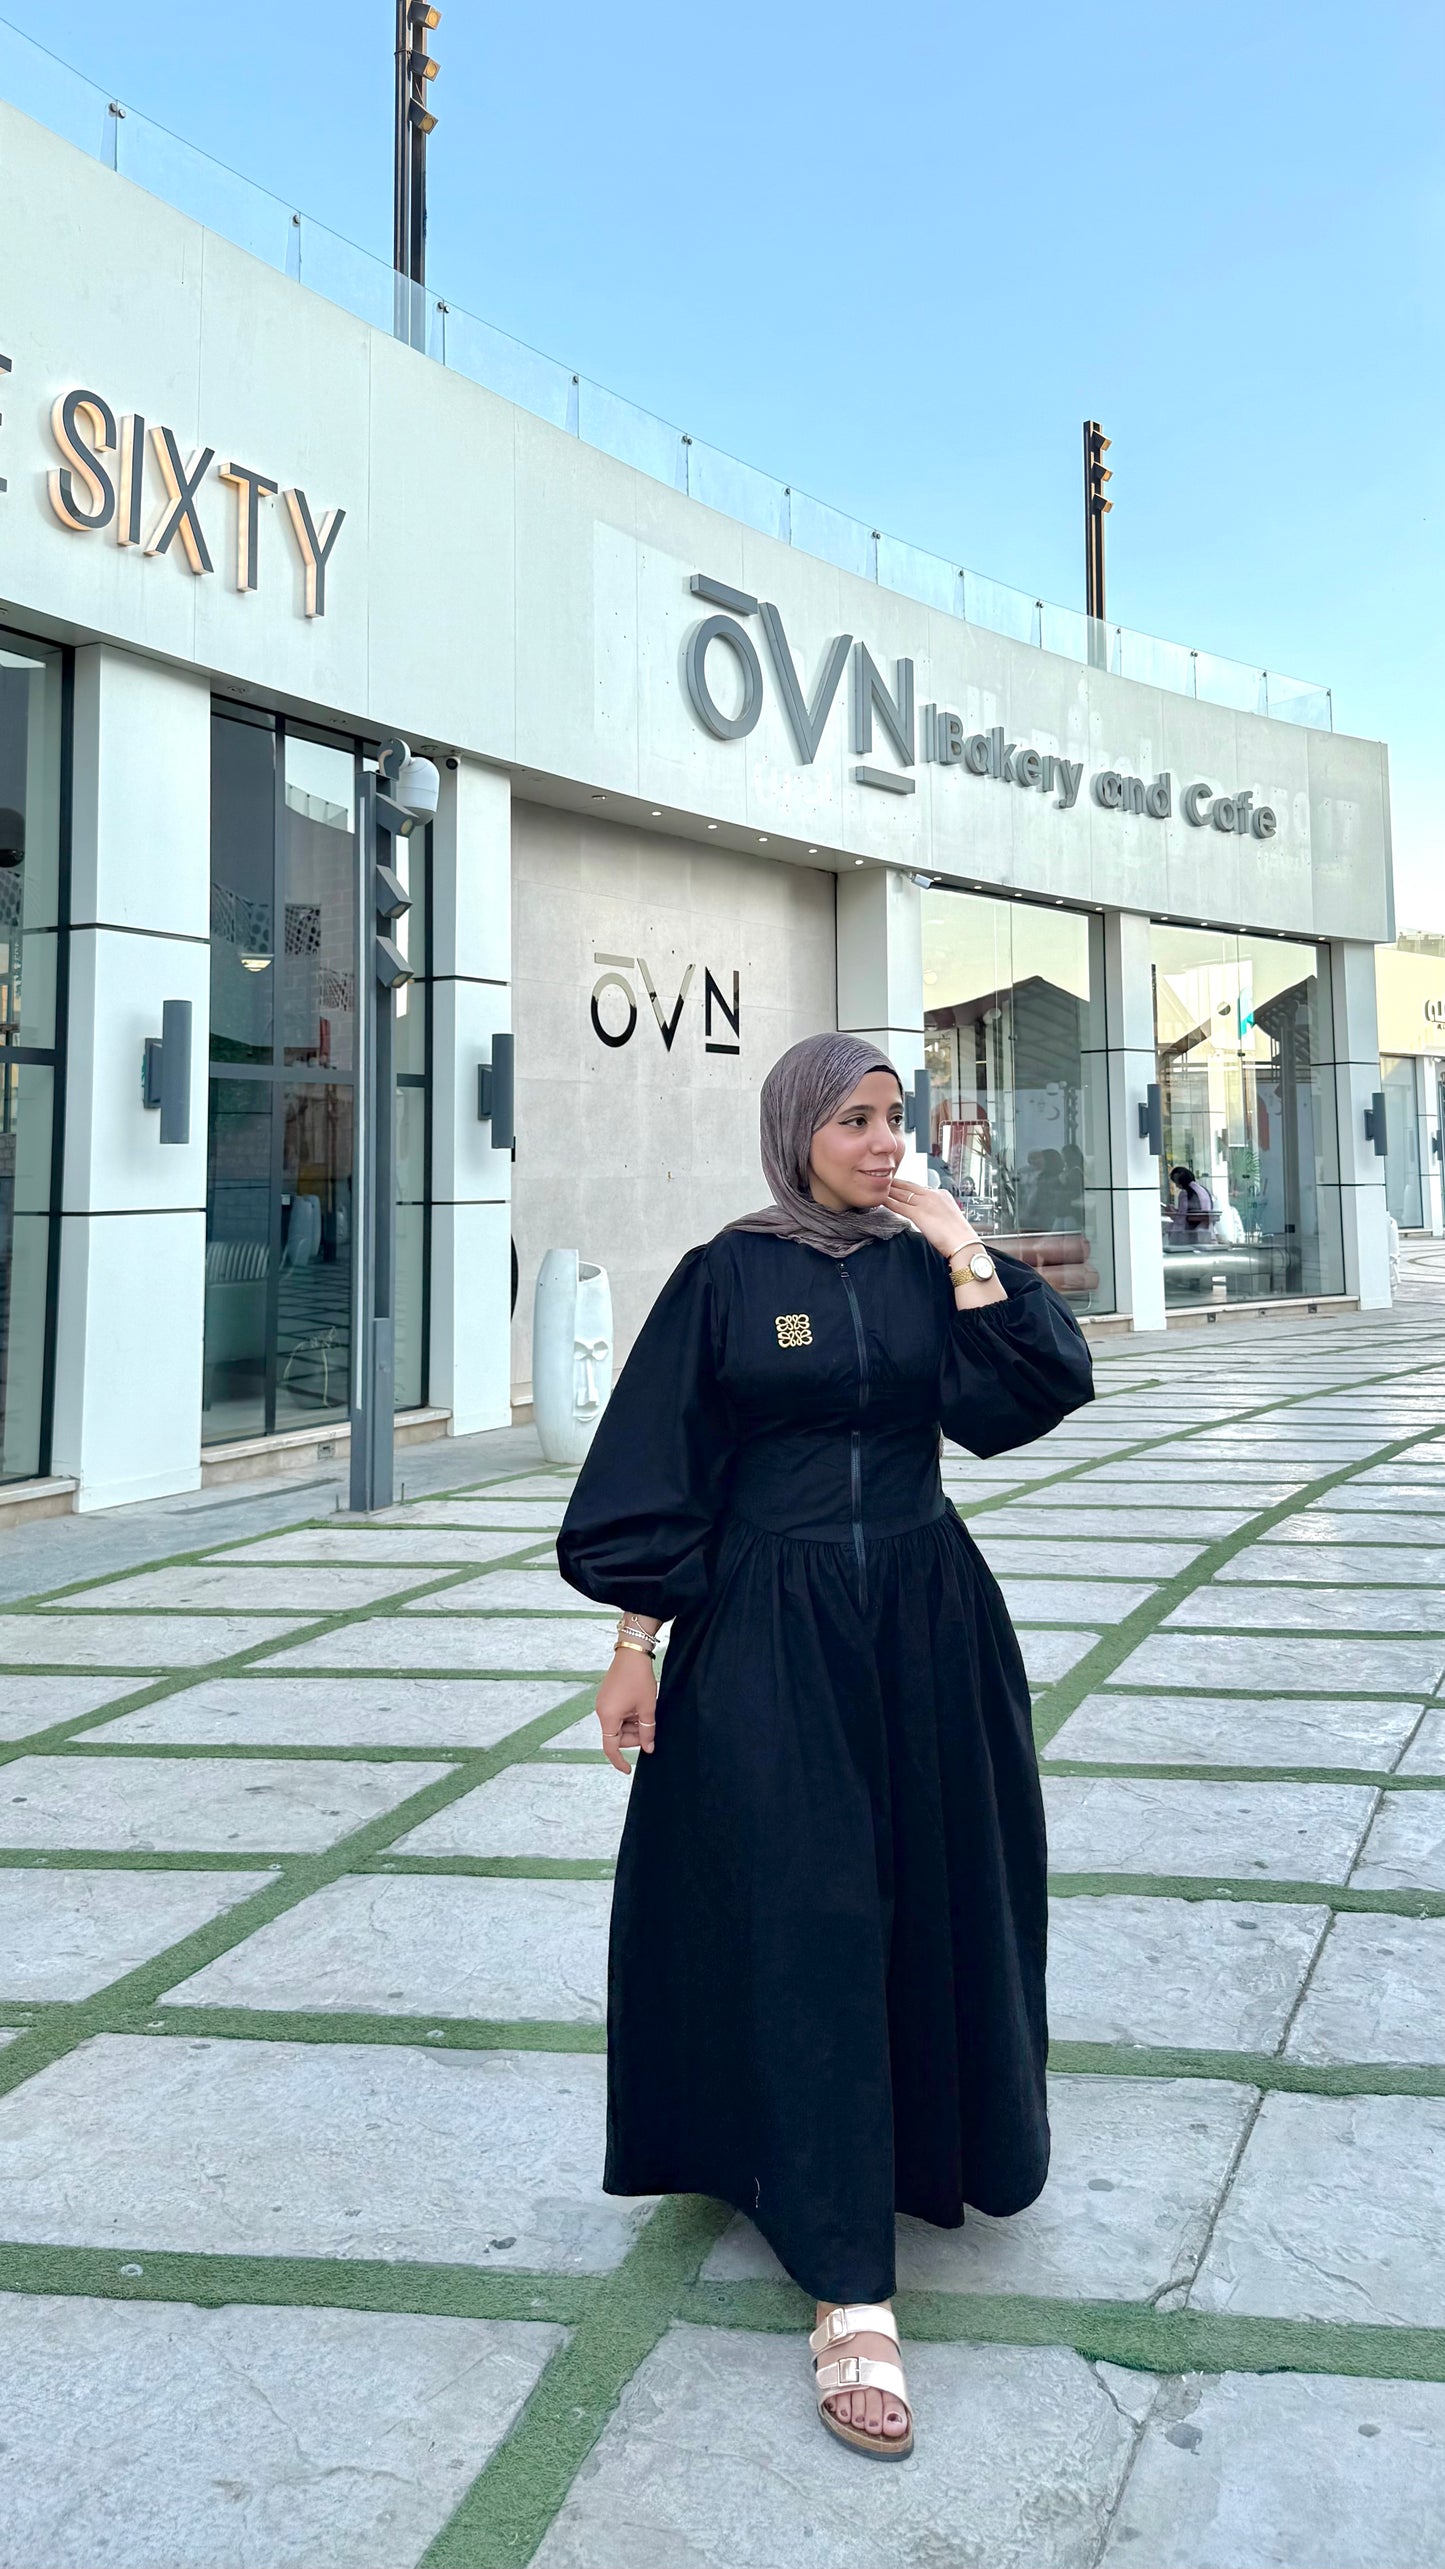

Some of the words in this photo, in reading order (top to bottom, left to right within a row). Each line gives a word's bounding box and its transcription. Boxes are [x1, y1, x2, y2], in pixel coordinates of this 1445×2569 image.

[47, 389, 347, 618] SIXTY
[938, 711, 1083, 808] Bakery
[1095, 770, 1171, 818] and
[1186, 782, 1277, 839] Cafe
